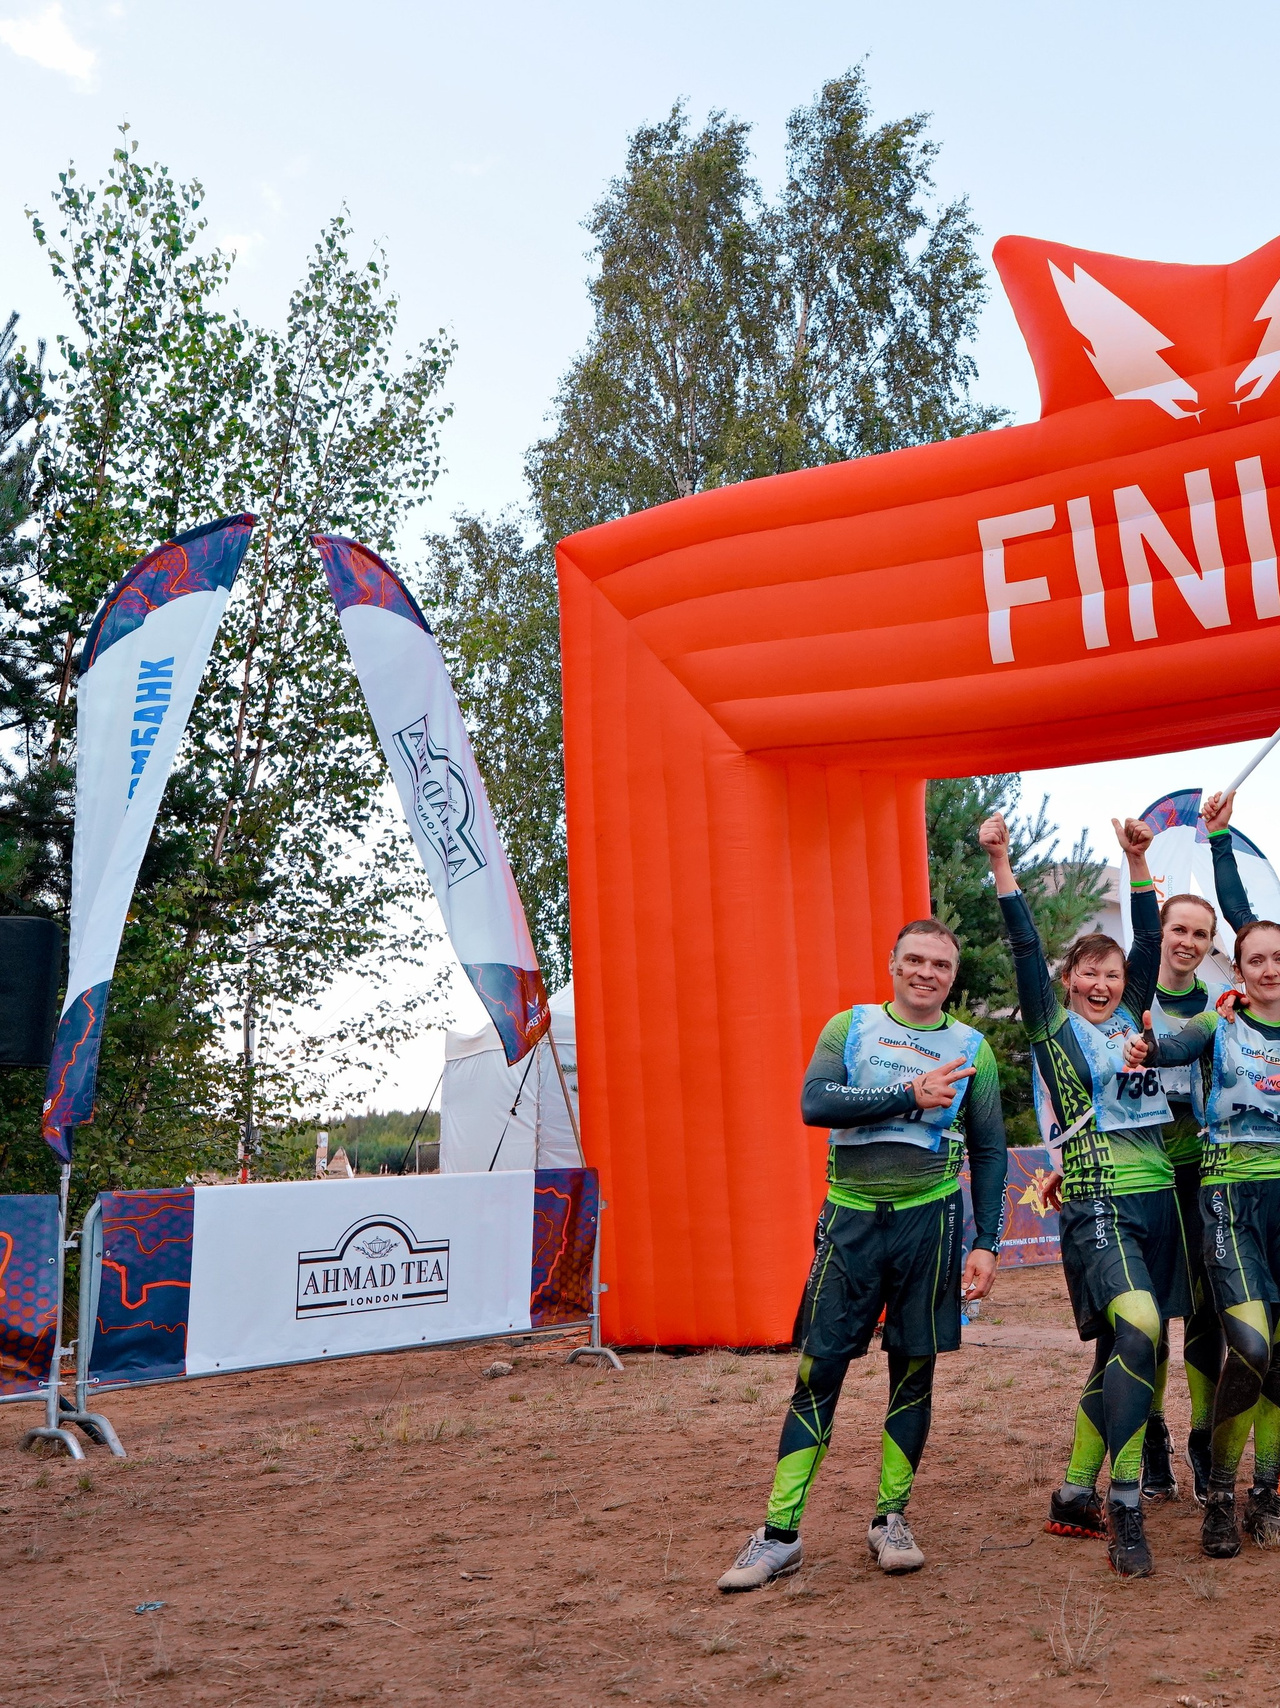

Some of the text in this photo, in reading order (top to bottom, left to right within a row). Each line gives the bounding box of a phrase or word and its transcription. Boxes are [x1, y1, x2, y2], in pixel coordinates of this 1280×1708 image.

[878, 1036, 941, 1059] ГОНКА ГЕРОЕВ
[1241, 1046, 1265, 1057] ГОНКА
[825, 1081, 900, 1095] Greenway
[999, 1238, 1027, 1247] РУЖЕННЫХ
[303, 1259, 444, 1295] AHMAD TEA
[350, 1293, 399, 1306] LONDON
